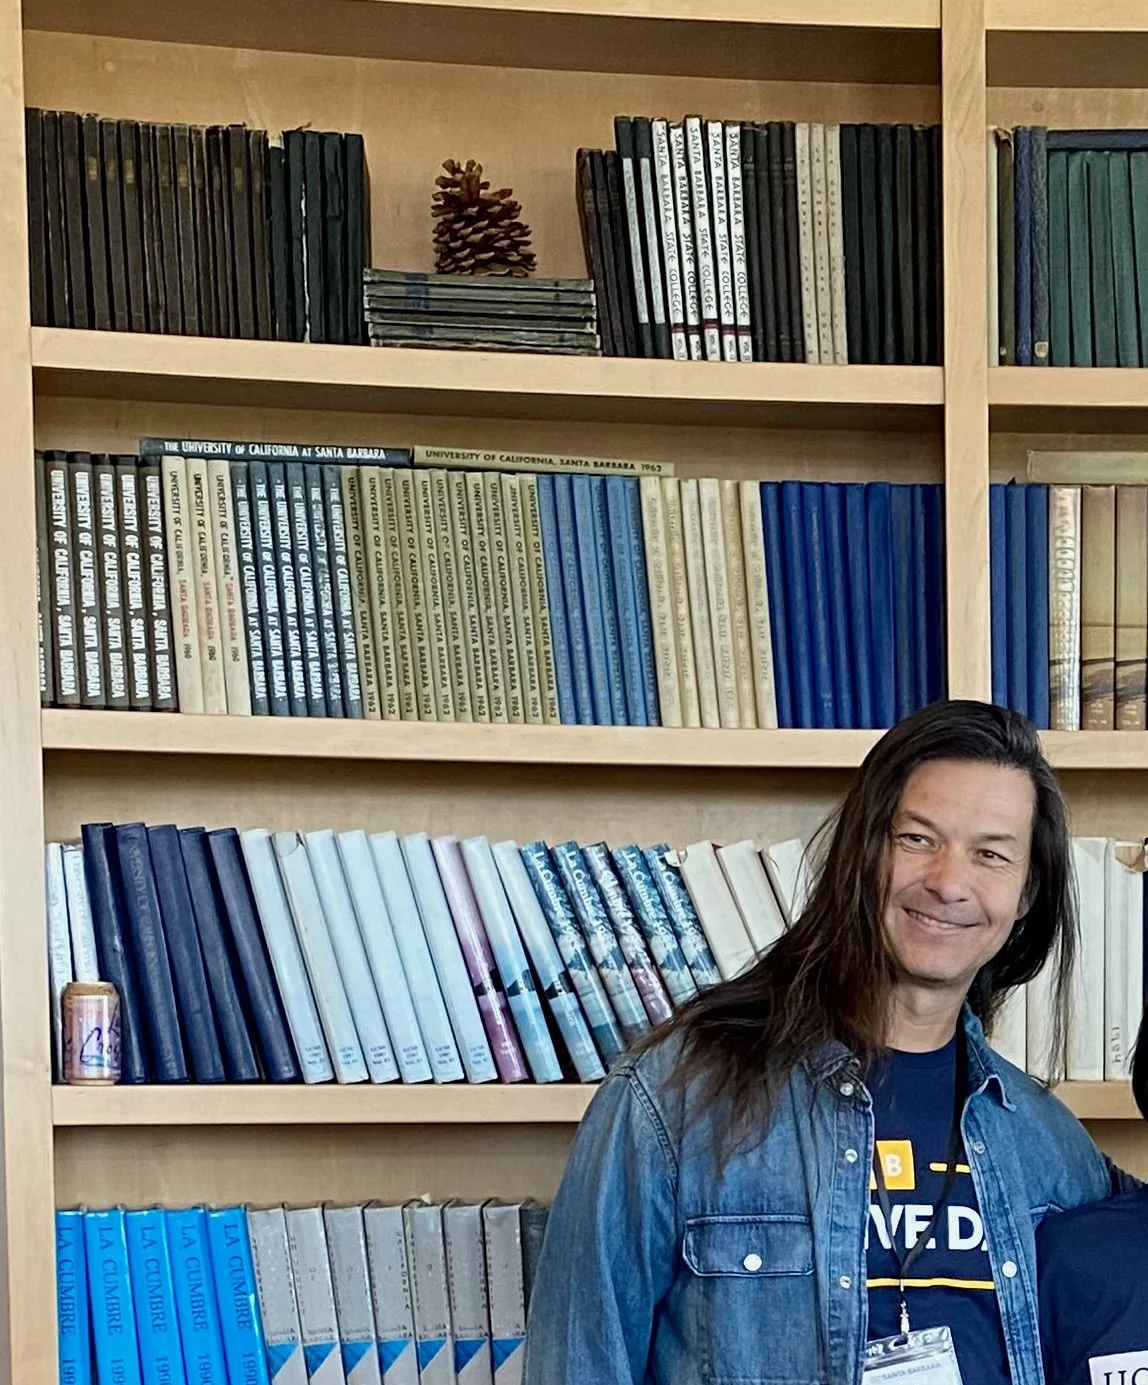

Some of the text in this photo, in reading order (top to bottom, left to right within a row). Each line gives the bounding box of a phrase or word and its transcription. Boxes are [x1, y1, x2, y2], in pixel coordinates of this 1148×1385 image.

[657, 131, 681, 315] SANTA BARBARA STATE COLLEGE
[675, 134, 697, 316] SANTA BARBARA STATE COLLEGE
[690, 128, 714, 310] SANTA BARBARA STATE COLLEGE
[711, 132, 732, 316] SANTA BARBARA STATE COLLEGE
[730, 134, 748, 317] SANTA BARBARA STATE COLLEGE
[165, 442, 178, 452] THE
[182, 442, 232, 454] UNIVERSITY
[249, 444, 299, 457] CALIFORNIA
[302, 448, 312, 458] AT
[315, 446, 344, 458] SANTA
[347, 448, 386, 460] BARBARA
[426, 450, 481, 461] UNIVERSITY
[560, 459, 589, 468] SANTA
[593, 461, 636, 471] BARBARA
[641, 463, 662, 472] 1962
[51, 470, 67, 528] UNIVERSITY
[369, 478, 380, 532] UNIVERSITY
[402, 480, 414, 533] UNIVERSITY
[491, 483, 502, 536] UNIVERSITY
[54, 530, 67, 544] OF
[380, 609, 389, 641] SANTA
[415, 613, 425, 642] SANTA
[503, 615, 513, 645] SANTA
[59, 650, 75, 695] BARBARA
[383, 645, 393, 688] BARBARA
[418, 646, 429, 688] BARBARA
[506, 649, 517, 691] BARBARA
[58, 1226, 73, 1250] LA
[99, 1226, 114, 1250] LA
[141, 1226, 157, 1249] LA
[181, 1225, 197, 1248] LA
[224, 1224, 240, 1247] LA
[60, 1258, 76, 1335] CUMBRE
[102, 1259, 123, 1335] CUMBRE
[144, 1258, 167, 1334] CUMBRE
[185, 1257, 208, 1332] CUMBRE
[228, 1256, 251, 1330] CUMBRE
